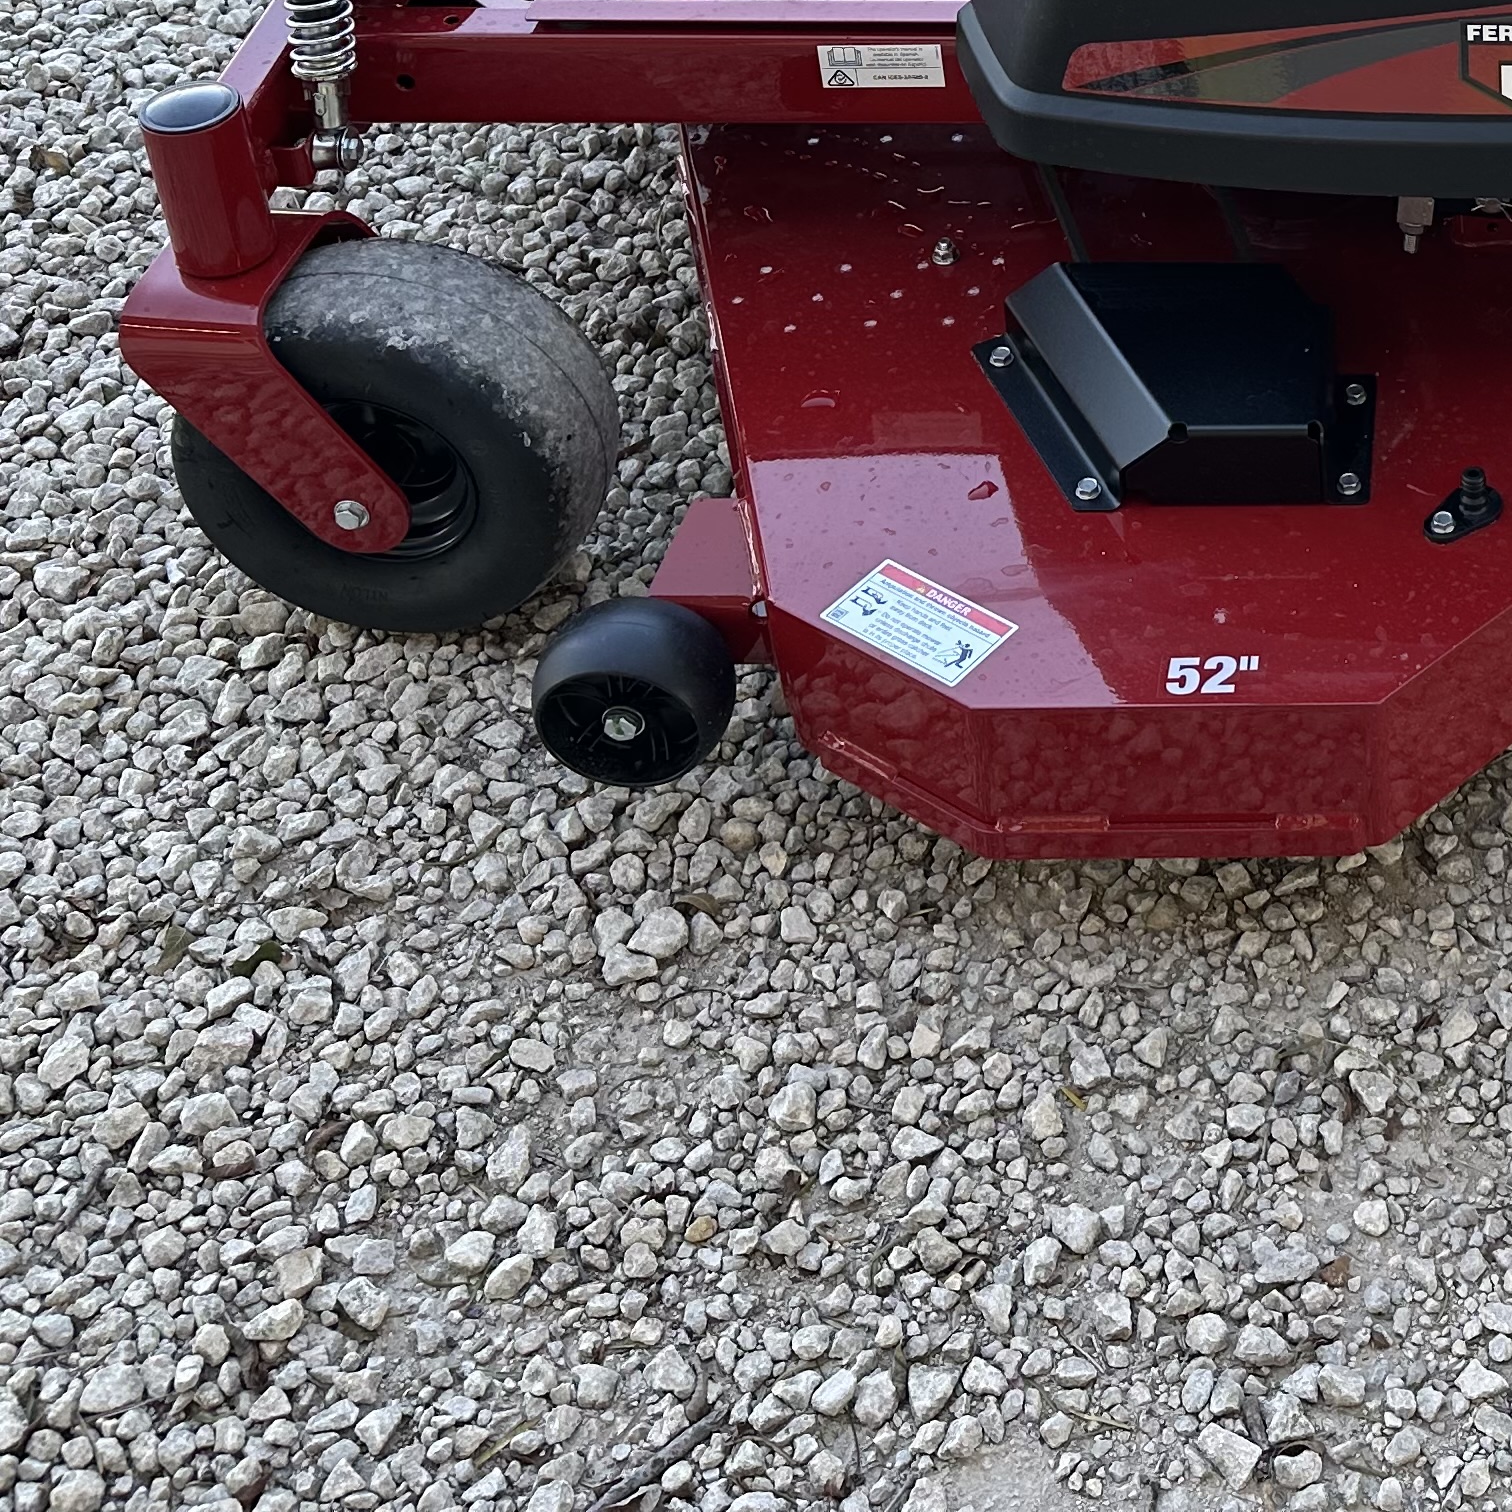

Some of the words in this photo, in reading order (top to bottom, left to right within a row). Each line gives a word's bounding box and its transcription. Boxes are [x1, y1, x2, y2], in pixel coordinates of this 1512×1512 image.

[914, 596, 926, 604] and
[926, 589, 971, 615] DANGER
[1165, 655, 1260, 695] 52"
